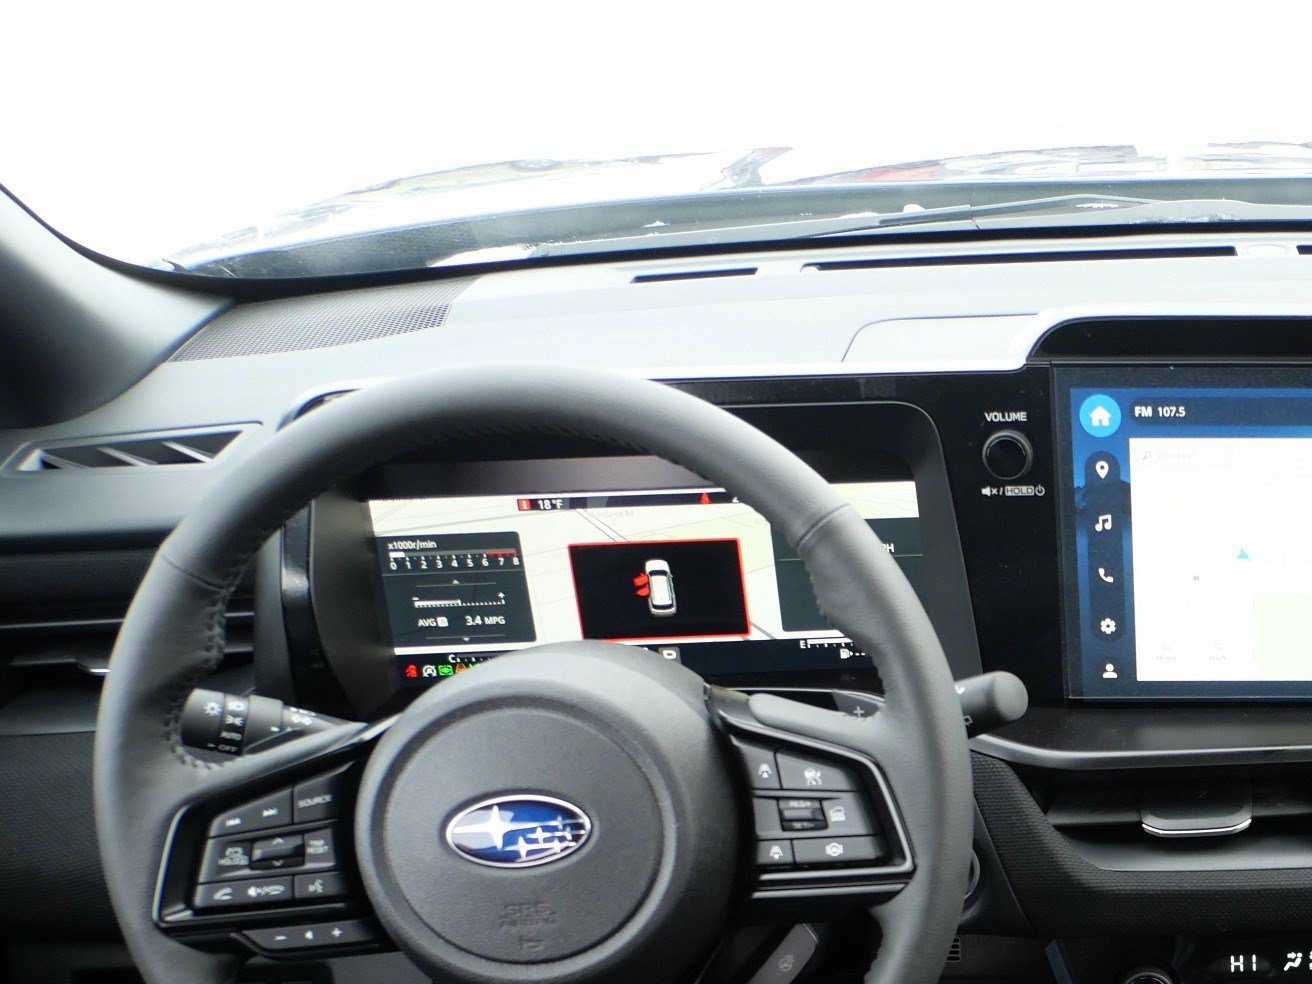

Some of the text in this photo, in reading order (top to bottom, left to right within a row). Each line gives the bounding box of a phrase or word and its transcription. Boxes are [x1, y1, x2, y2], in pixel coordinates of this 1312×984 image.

[984, 412, 1027, 422] VOLUME
[1134, 406, 1186, 418] FM 107.5
[388, 540, 437, 550] x1000r/min
[390, 557, 519, 570] 0 1 2 3 4 5 6 7 8
[418, 616, 506, 627] AVG 3.4 MPG
[449, 655, 457, 663] C
